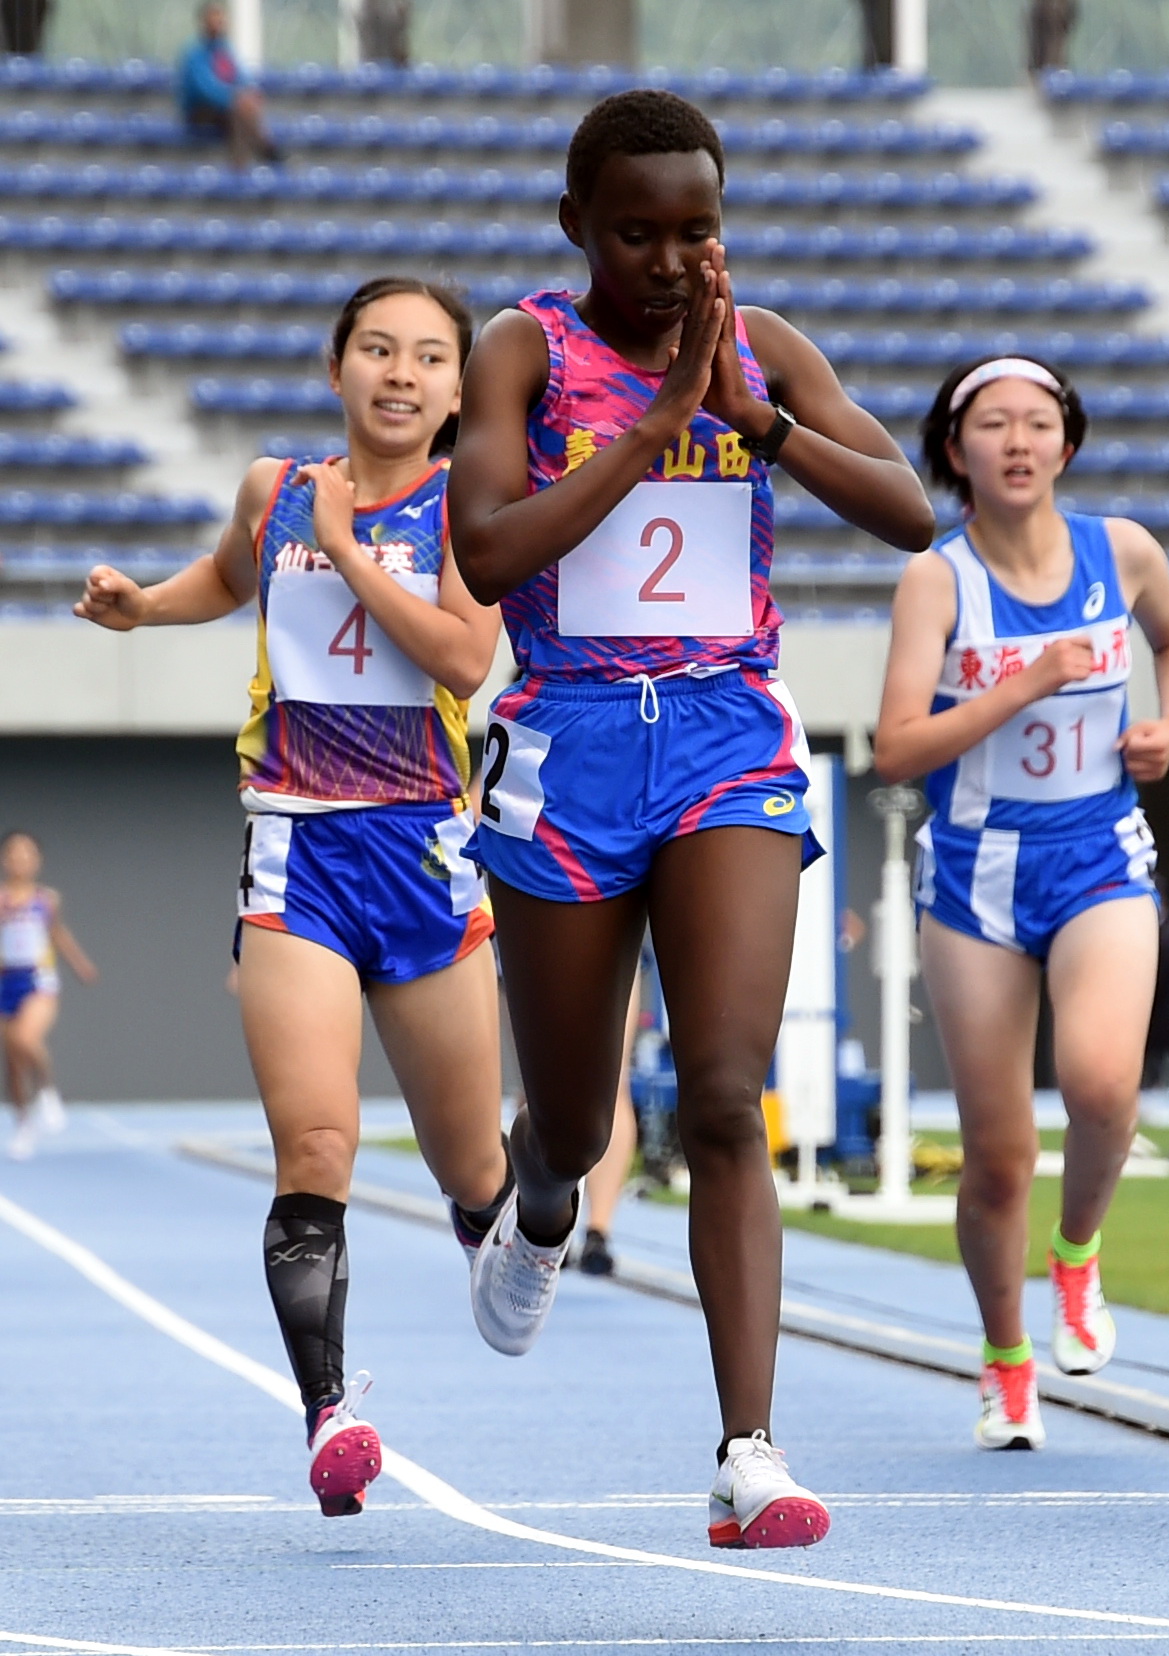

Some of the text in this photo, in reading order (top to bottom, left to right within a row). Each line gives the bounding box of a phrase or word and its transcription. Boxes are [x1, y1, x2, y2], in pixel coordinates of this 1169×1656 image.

[561, 428, 750, 479] 青山田
[638, 517, 686, 603] 2
[328, 600, 373, 675] 4
[481, 722, 510, 824] 2
[1021, 714, 1085, 780] 31
